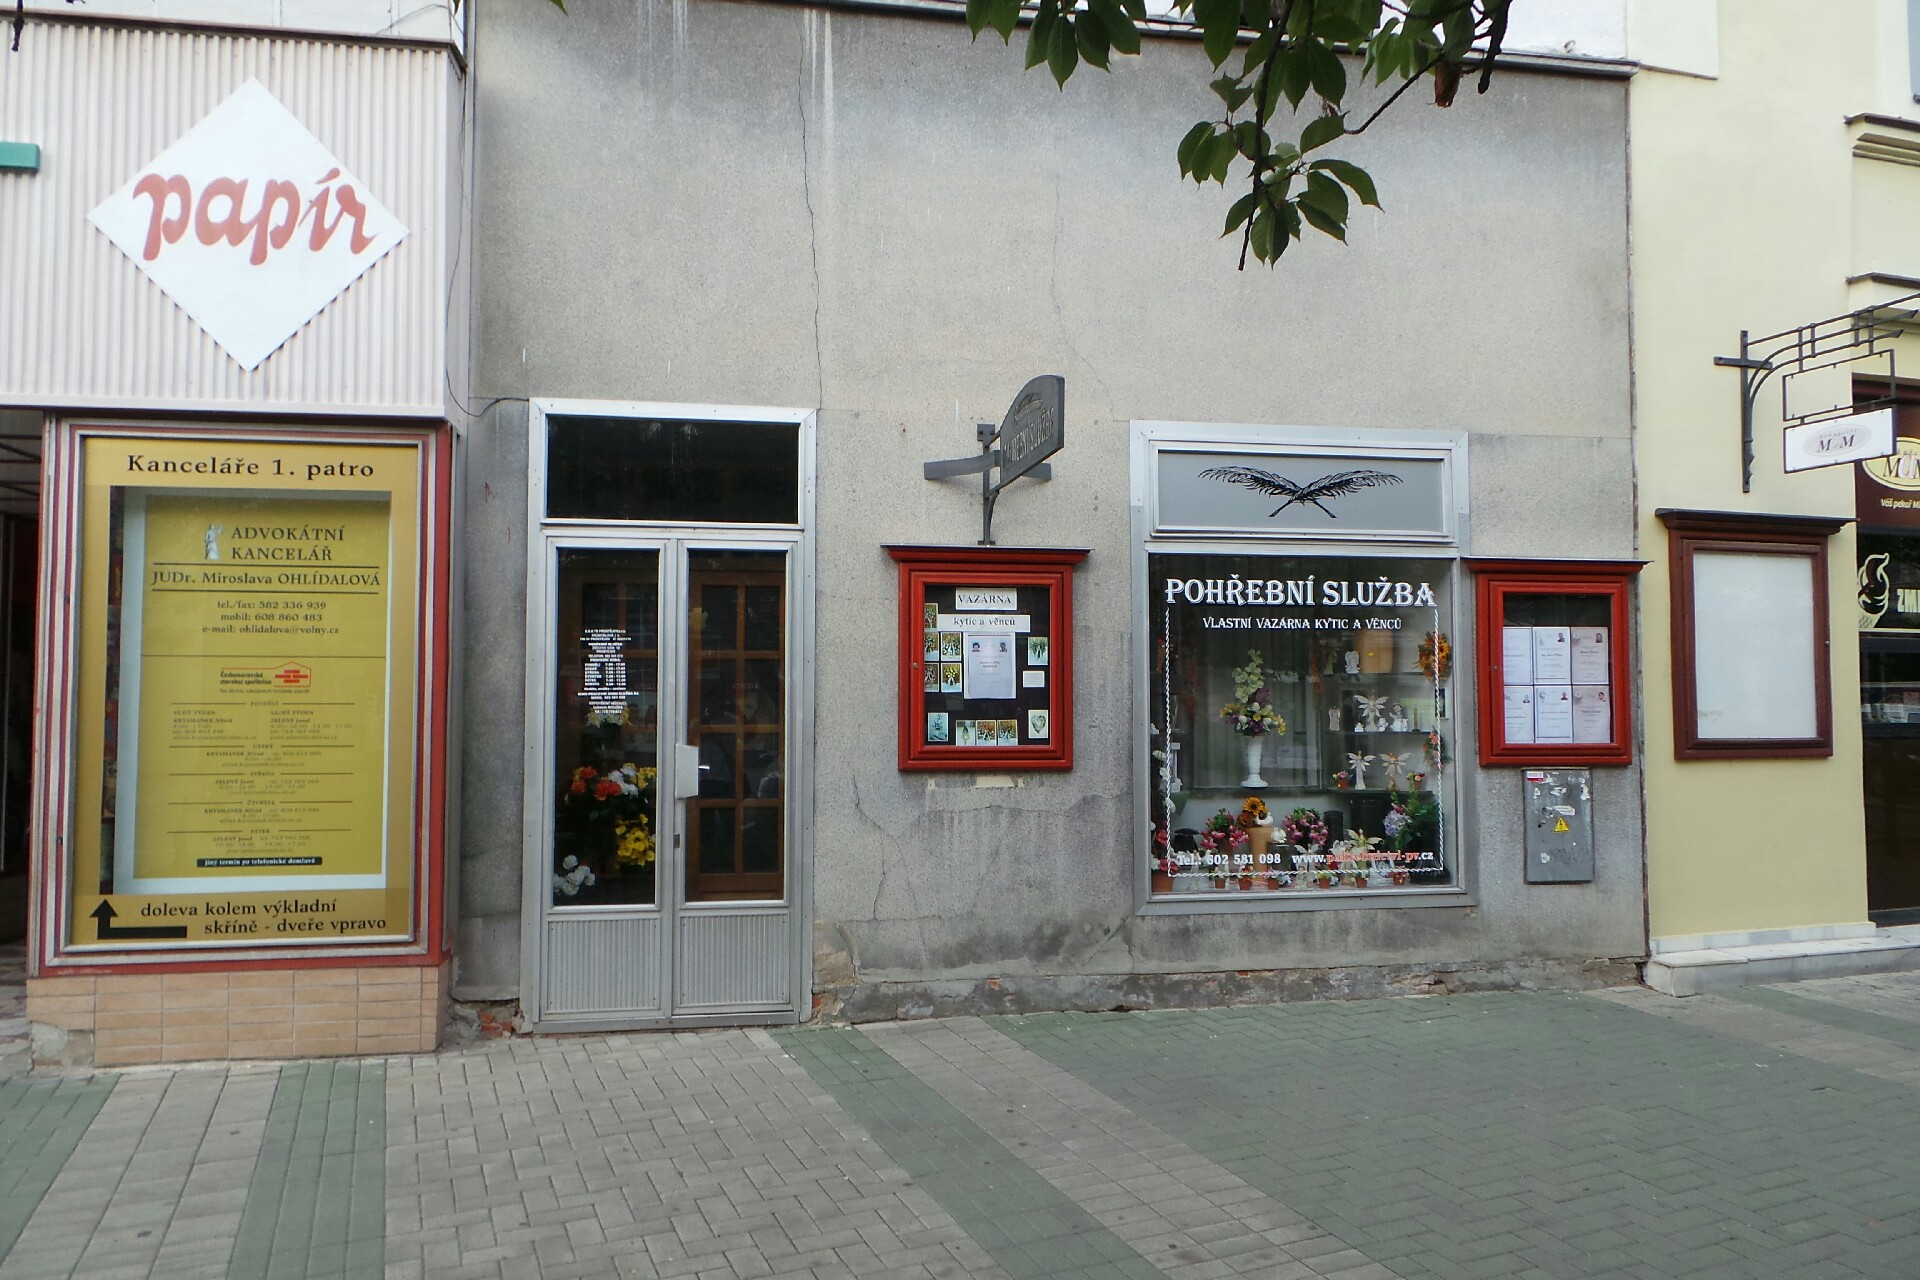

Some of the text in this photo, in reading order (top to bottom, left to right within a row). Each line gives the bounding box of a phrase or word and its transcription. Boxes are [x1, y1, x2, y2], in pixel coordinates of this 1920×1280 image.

[133, 166, 380, 266] papír
[127, 454, 375, 481] Kanceláře 1. patro
[231, 524, 346, 541] ADVOKÁTNÍ
[231, 544, 332, 561] KANCELÁŘ
[150, 571, 380, 586] JUDr. Miroslava OHLÍDALOVÁ
[958, 593, 1012, 604] VAZÁRNA
[1165, 573, 1438, 608] POHŘEBNÍ SLUŽBA
[217, 600, 327, 610] tel./fax: 582 336 939
[1897, 588, 1920, 613] ZM
[220, 612, 323, 622] mobil: 608 860 483
[953, 617, 977, 628] kytic
[988, 617, 1015, 626] věnců
[1202, 616, 1402, 631] VLASTNÍ VAZÁRNA KYTIC A VĚNCŮ
[202, 625, 236, 634] e-mail:
[1177, 853, 1201, 866] Tel.:
[1206, 853, 1228, 865] 602
[1233, 852, 1254, 865] 581
[1259, 852, 1281, 865] 098
[141, 899, 338, 919] doleva kolem výkladní
[204, 917, 258, 935] skříně
[276, 916, 324, 932] dveře
[330, 918, 387, 936] vpravo
